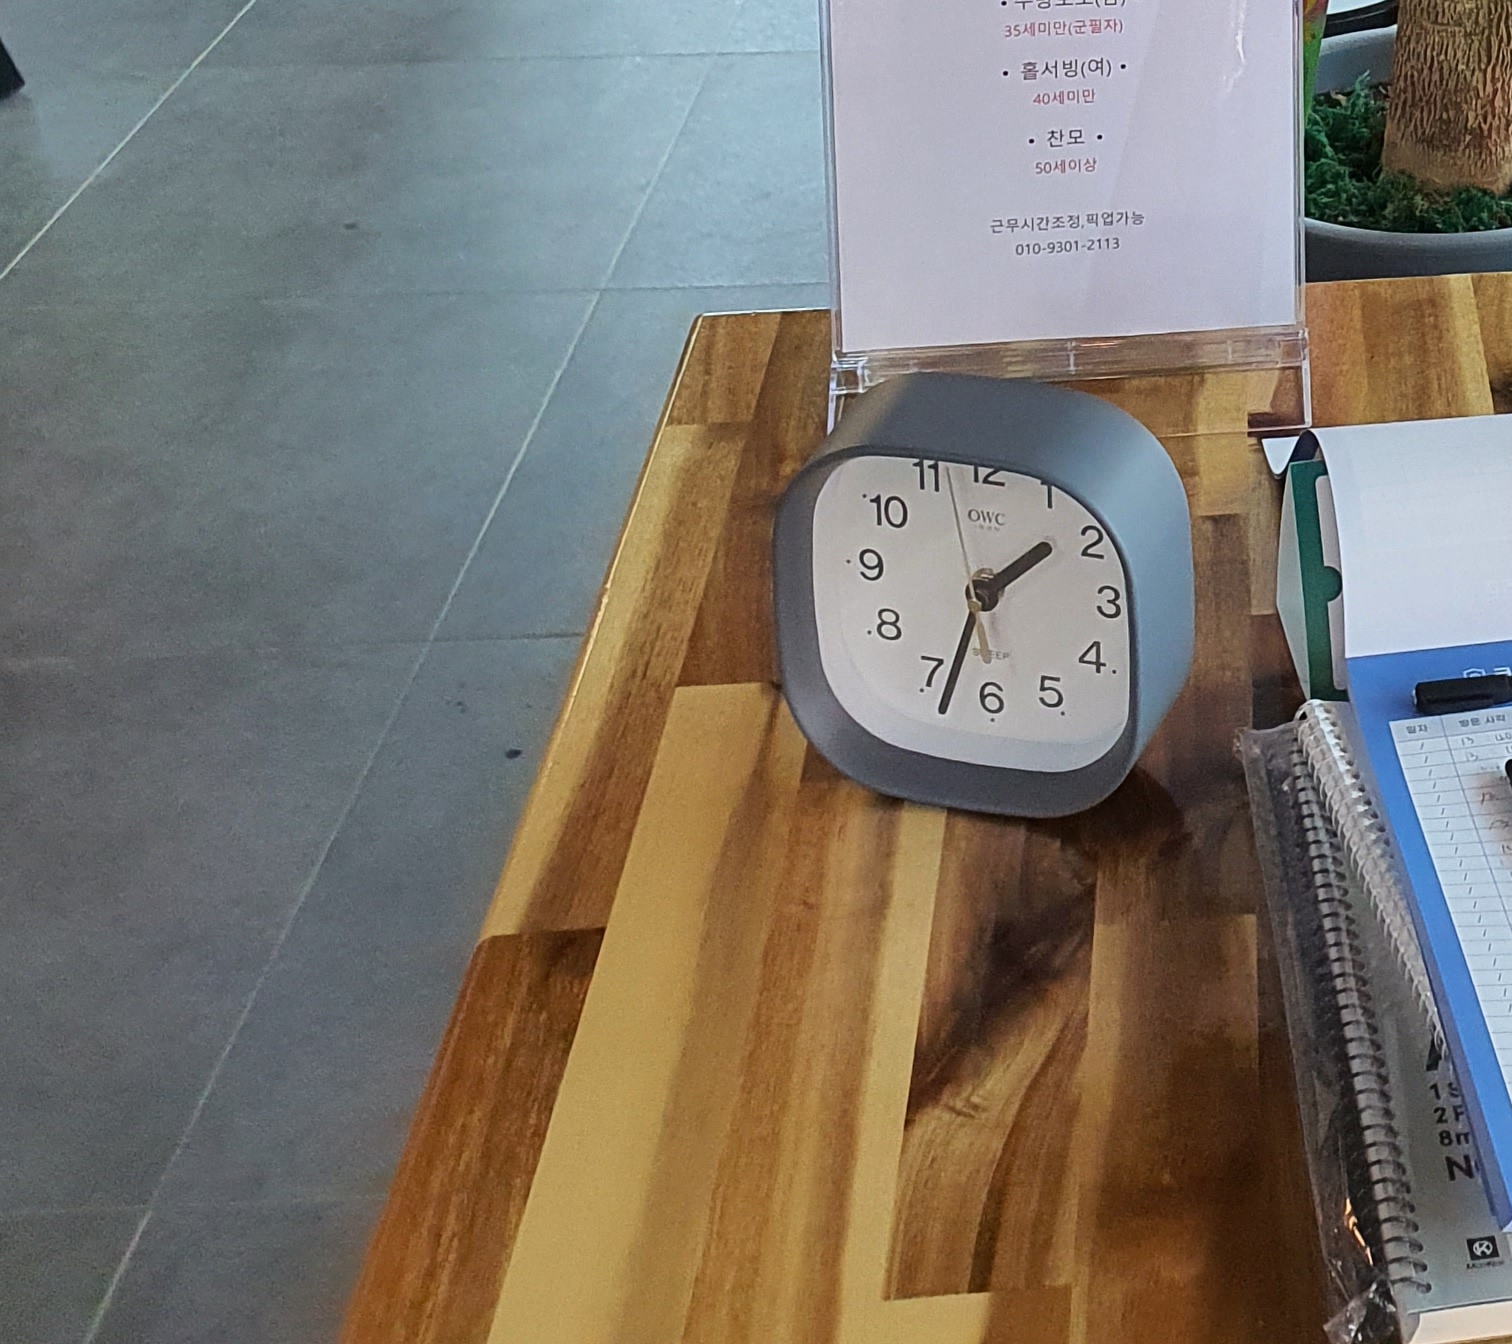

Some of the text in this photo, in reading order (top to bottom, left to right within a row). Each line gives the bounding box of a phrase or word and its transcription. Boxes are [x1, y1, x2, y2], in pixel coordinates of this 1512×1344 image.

[1004, 18, 1123, 38] 35세미만(군필자)
[1021, 57, 1112, 80] 홀서빙(여)
[1033, 88, 1095, 105] 40세미만
[1047, 129, 1085, 147] 찬모
[1035, 157, 1097, 174] 50세이상
[1015, 237, 1120, 256] 010-9301-2113
[912, 459, 940, 492] 11
[869, 493, 908, 528] 10
[967, 508, 1006, 526] OWC
[1080, 525, 1105, 559] 2
[858, 548, 884, 581] 9
[1097, 585, 1121, 618] 3
[876, 608, 902, 641] 8
[972, 647, 1010, 660] SEEP
[1079, 641, 1107, 674] 4
[920, 655, 944, 688] 7
[979, 682, 1005, 714] 6
[1039, 675, 1064, 708] 5
